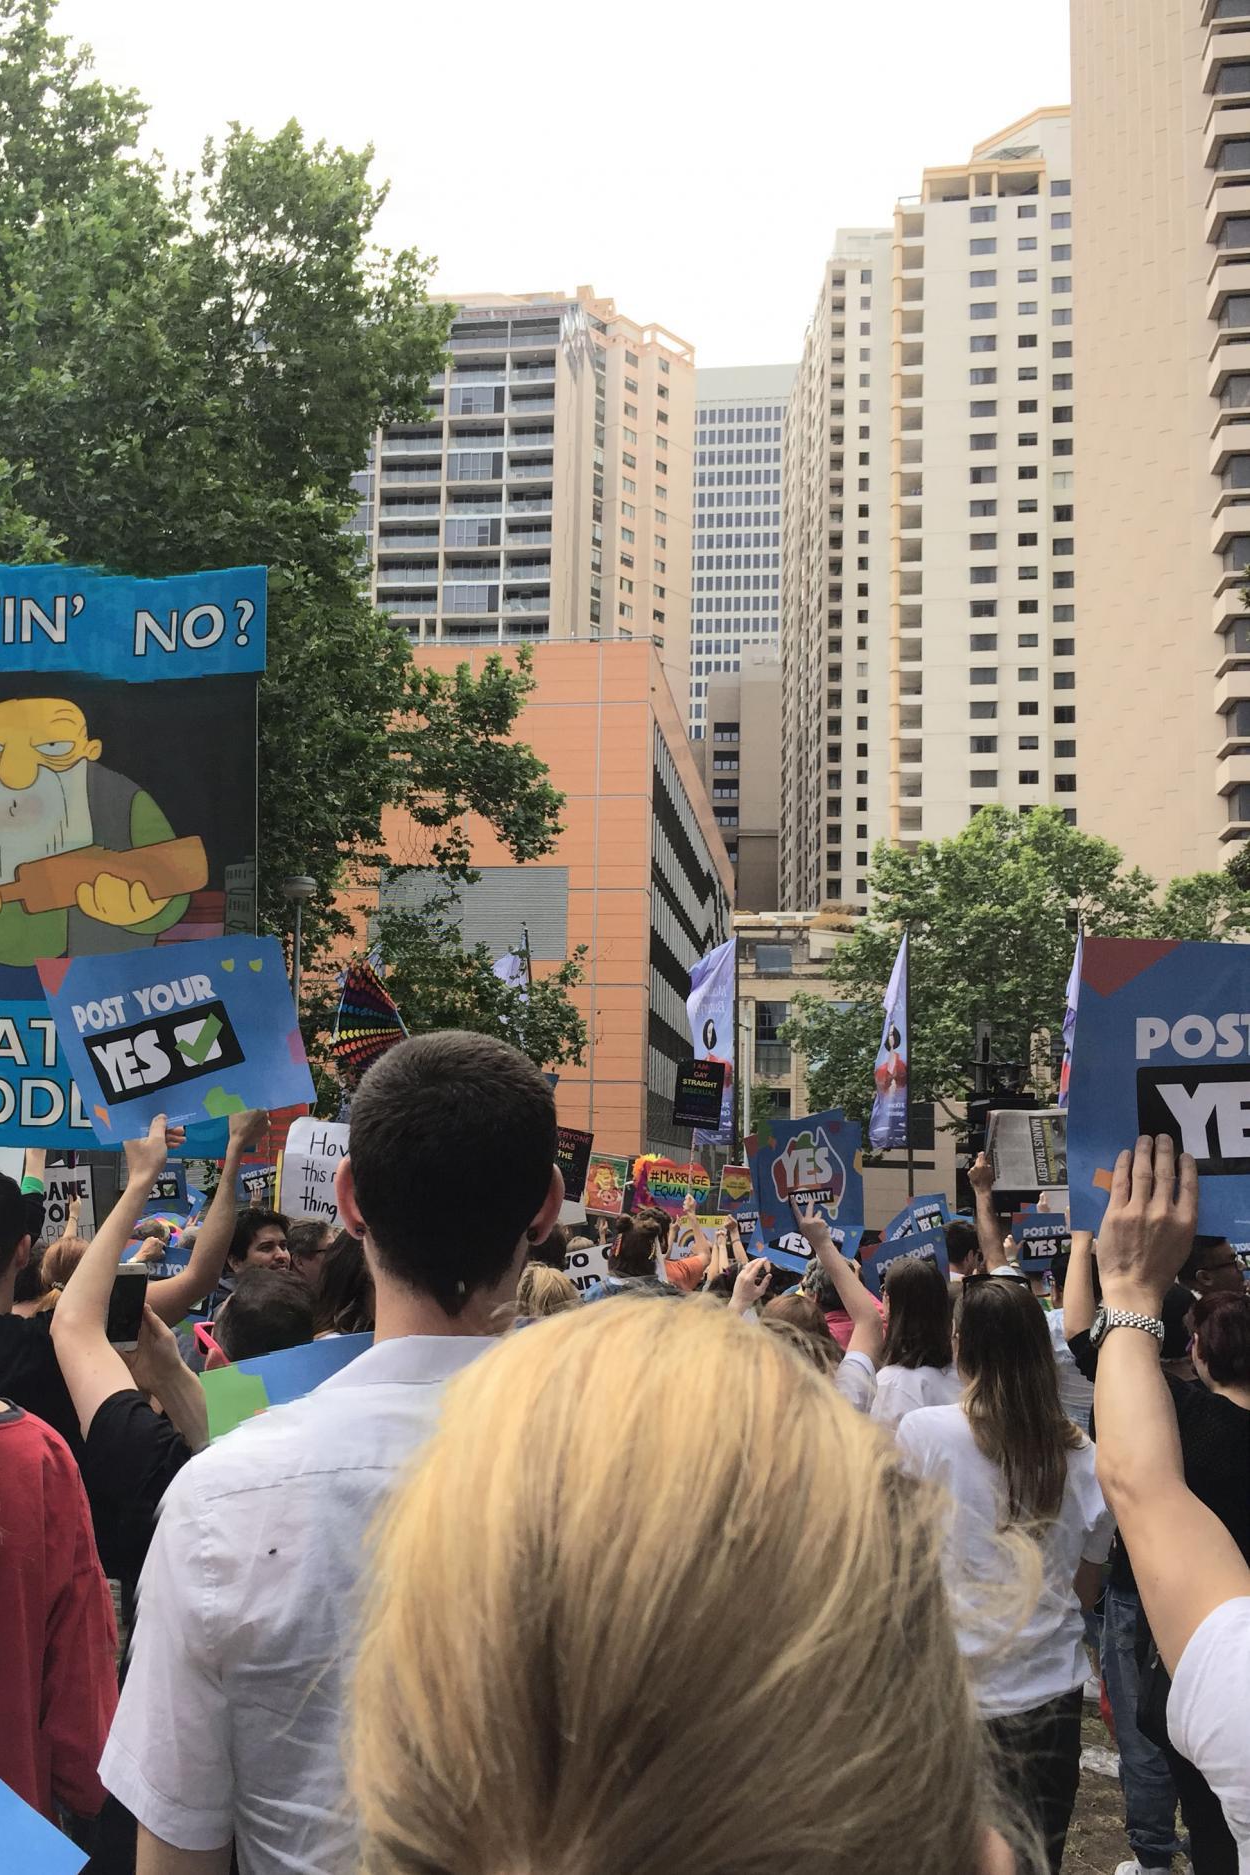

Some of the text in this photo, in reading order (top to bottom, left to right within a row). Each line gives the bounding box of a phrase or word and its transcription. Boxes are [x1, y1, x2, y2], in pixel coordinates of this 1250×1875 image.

[71, 974, 217, 1033] POST YOUR
[91, 1029, 171, 1093] YES
[682, 1078, 718, 1088] STRAIGHT
[1030, 1119, 1045, 1147] MANUS
[557, 1149, 573, 1160] THE
[558, 1141, 575, 1151] HAS
[301, 1160, 327, 1183] this
[780, 1148, 833, 1187] YES
[1034, 1147, 1051, 1182] TRAGEDY
[157, 1171, 177, 1181] OUR
[244, 1177, 266, 1192] YES
[299, 1185, 338, 1225] thing
[739, 1220, 756, 1233] YES
[1023, 1226, 1049, 1238] POST
[778, 1231, 812, 1256] YES
[1027, 1239, 1057, 1257] YES
